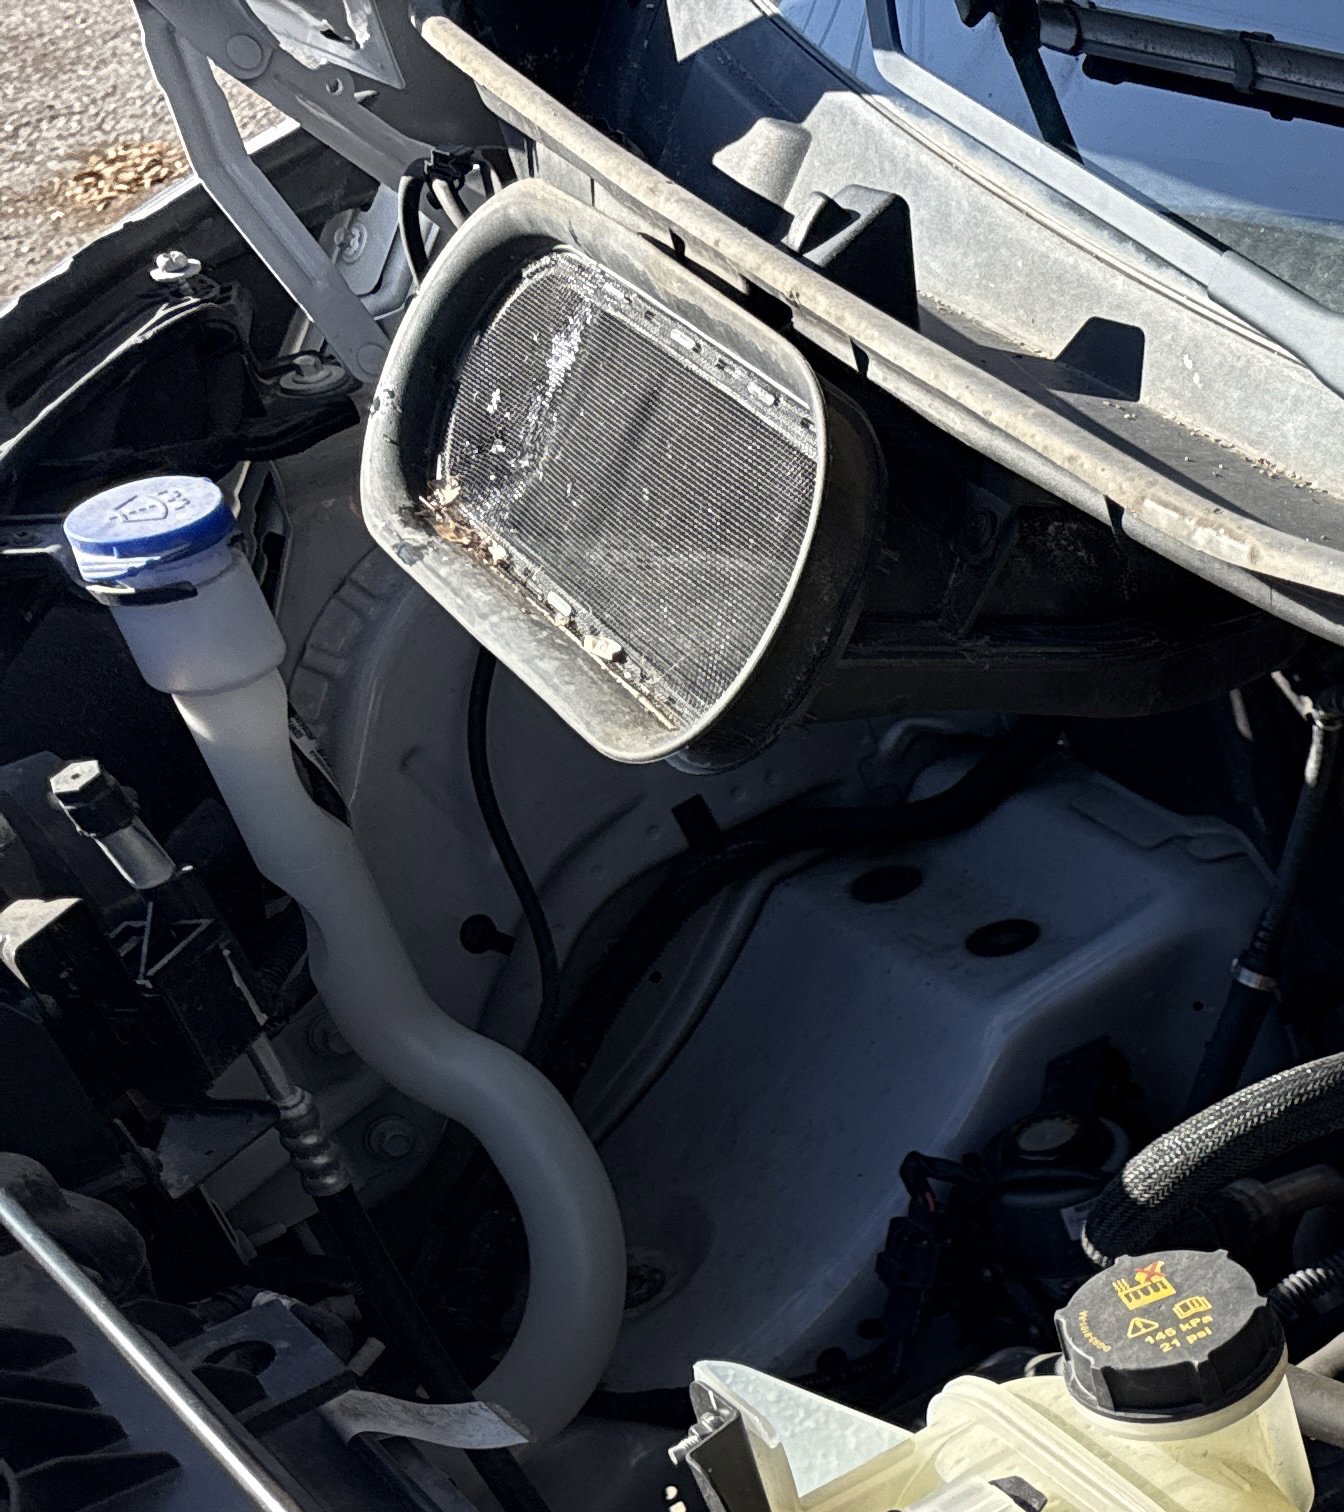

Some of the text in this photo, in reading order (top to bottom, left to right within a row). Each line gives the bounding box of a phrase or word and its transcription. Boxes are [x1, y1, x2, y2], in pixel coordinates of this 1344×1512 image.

[1145, 1315, 1213, 1344] 145 kPa
[1160, 1327, 1212, 1353] 21 psi
